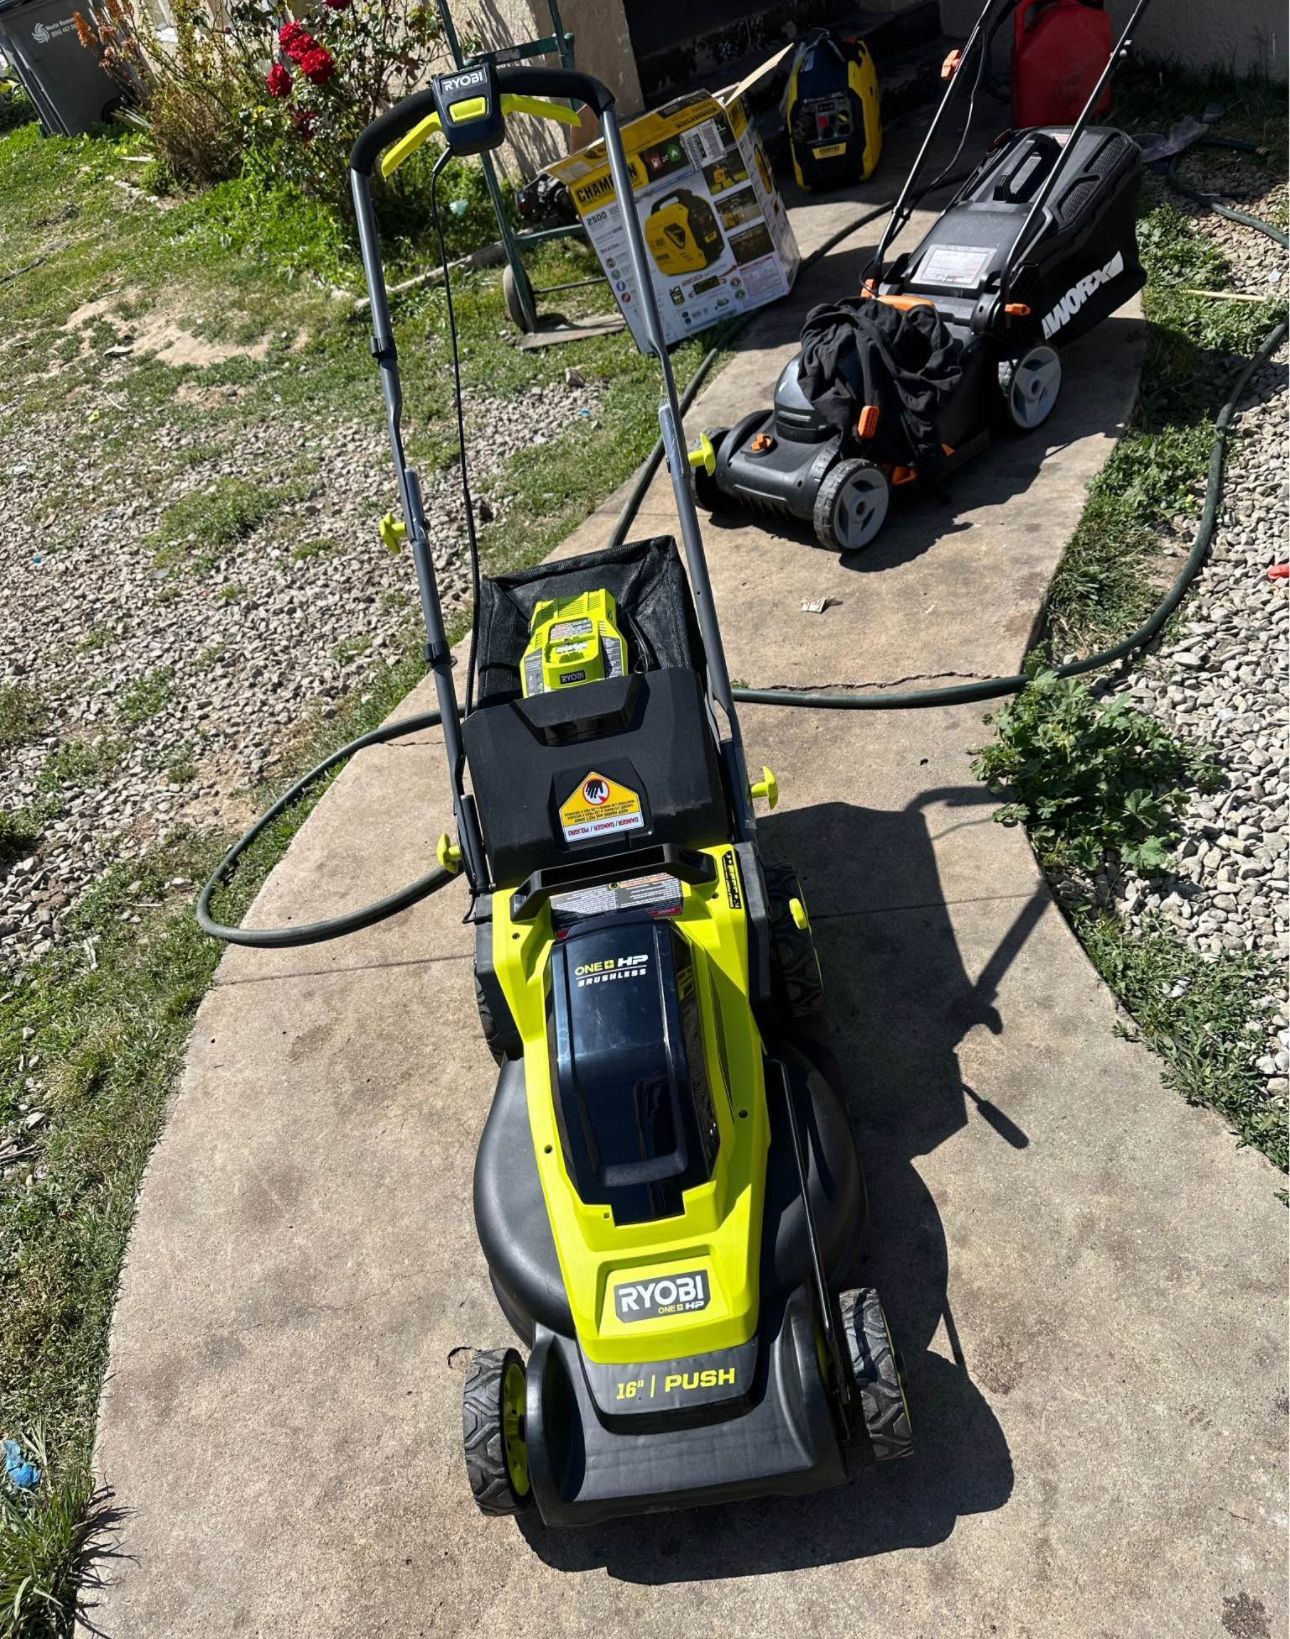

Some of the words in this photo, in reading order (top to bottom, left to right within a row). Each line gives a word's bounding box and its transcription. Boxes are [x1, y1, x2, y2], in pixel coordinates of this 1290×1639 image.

[443, 71, 484, 91] RYOBI
[586, 210, 607, 226] 2500
[1041, 250, 1124, 340] WORX
[561, 671, 585, 682] RYOBI
[594, 823, 615, 831] DANGER
[619, 817, 639, 826] DANGER
[567, 828, 590, 836] PELIGRO
[617, 954, 649, 967] HP
[577, 968, 647, 988] BRUSHLESS
[618, 1275, 704, 1312] RYOBI
[685, 1300, 705, 1310] HP
[616, 1379, 645, 1400] 16"
[664, 1367, 736, 1393] PUSH
